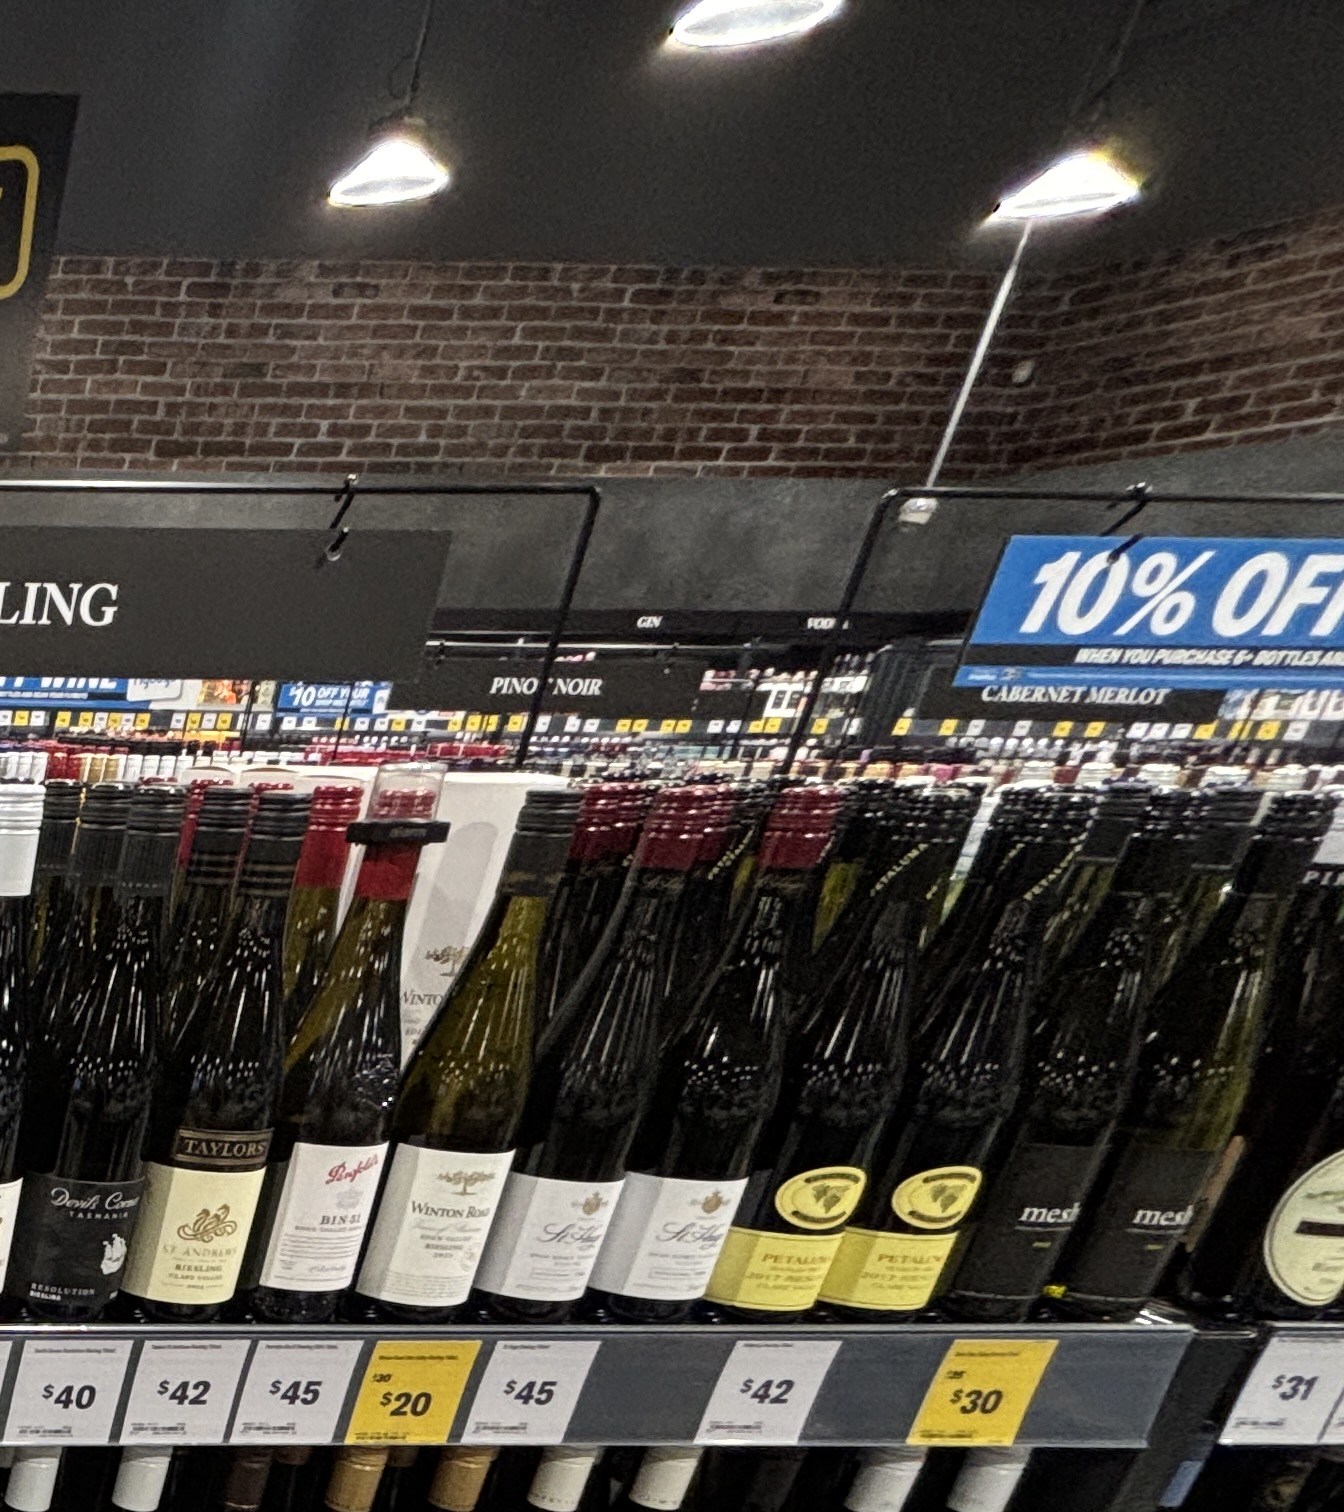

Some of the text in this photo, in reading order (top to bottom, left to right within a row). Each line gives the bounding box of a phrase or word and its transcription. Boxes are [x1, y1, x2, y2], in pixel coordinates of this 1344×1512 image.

[1019, 550, 1217, 636] 10%
[636, 616, 663, 629] GIN
[1074, 648, 1322, 666] WHEN YOU PURCHASE BOTTLES
[553, 677, 603, 696] NOIR
[981, 686, 1172, 705] CABERNET MERLOT
[183, 1136, 265, 1159] TAYLORS
[320, 1215, 348, 1226] BIN
[412, 1200, 465, 1219] WINTON
[42, 1383, 96, 1410] $40
[157, 1379, 211, 1407] $42
[269, 1379, 323, 1406] $45
[504, 1379, 557, 1407] $45
[741, 1377, 794, 1405] $42
[1273, 1374, 1318, 1401] $31
[380, 1390, 432, 1418] $20
[951, 1389, 1002, 1415] $30
